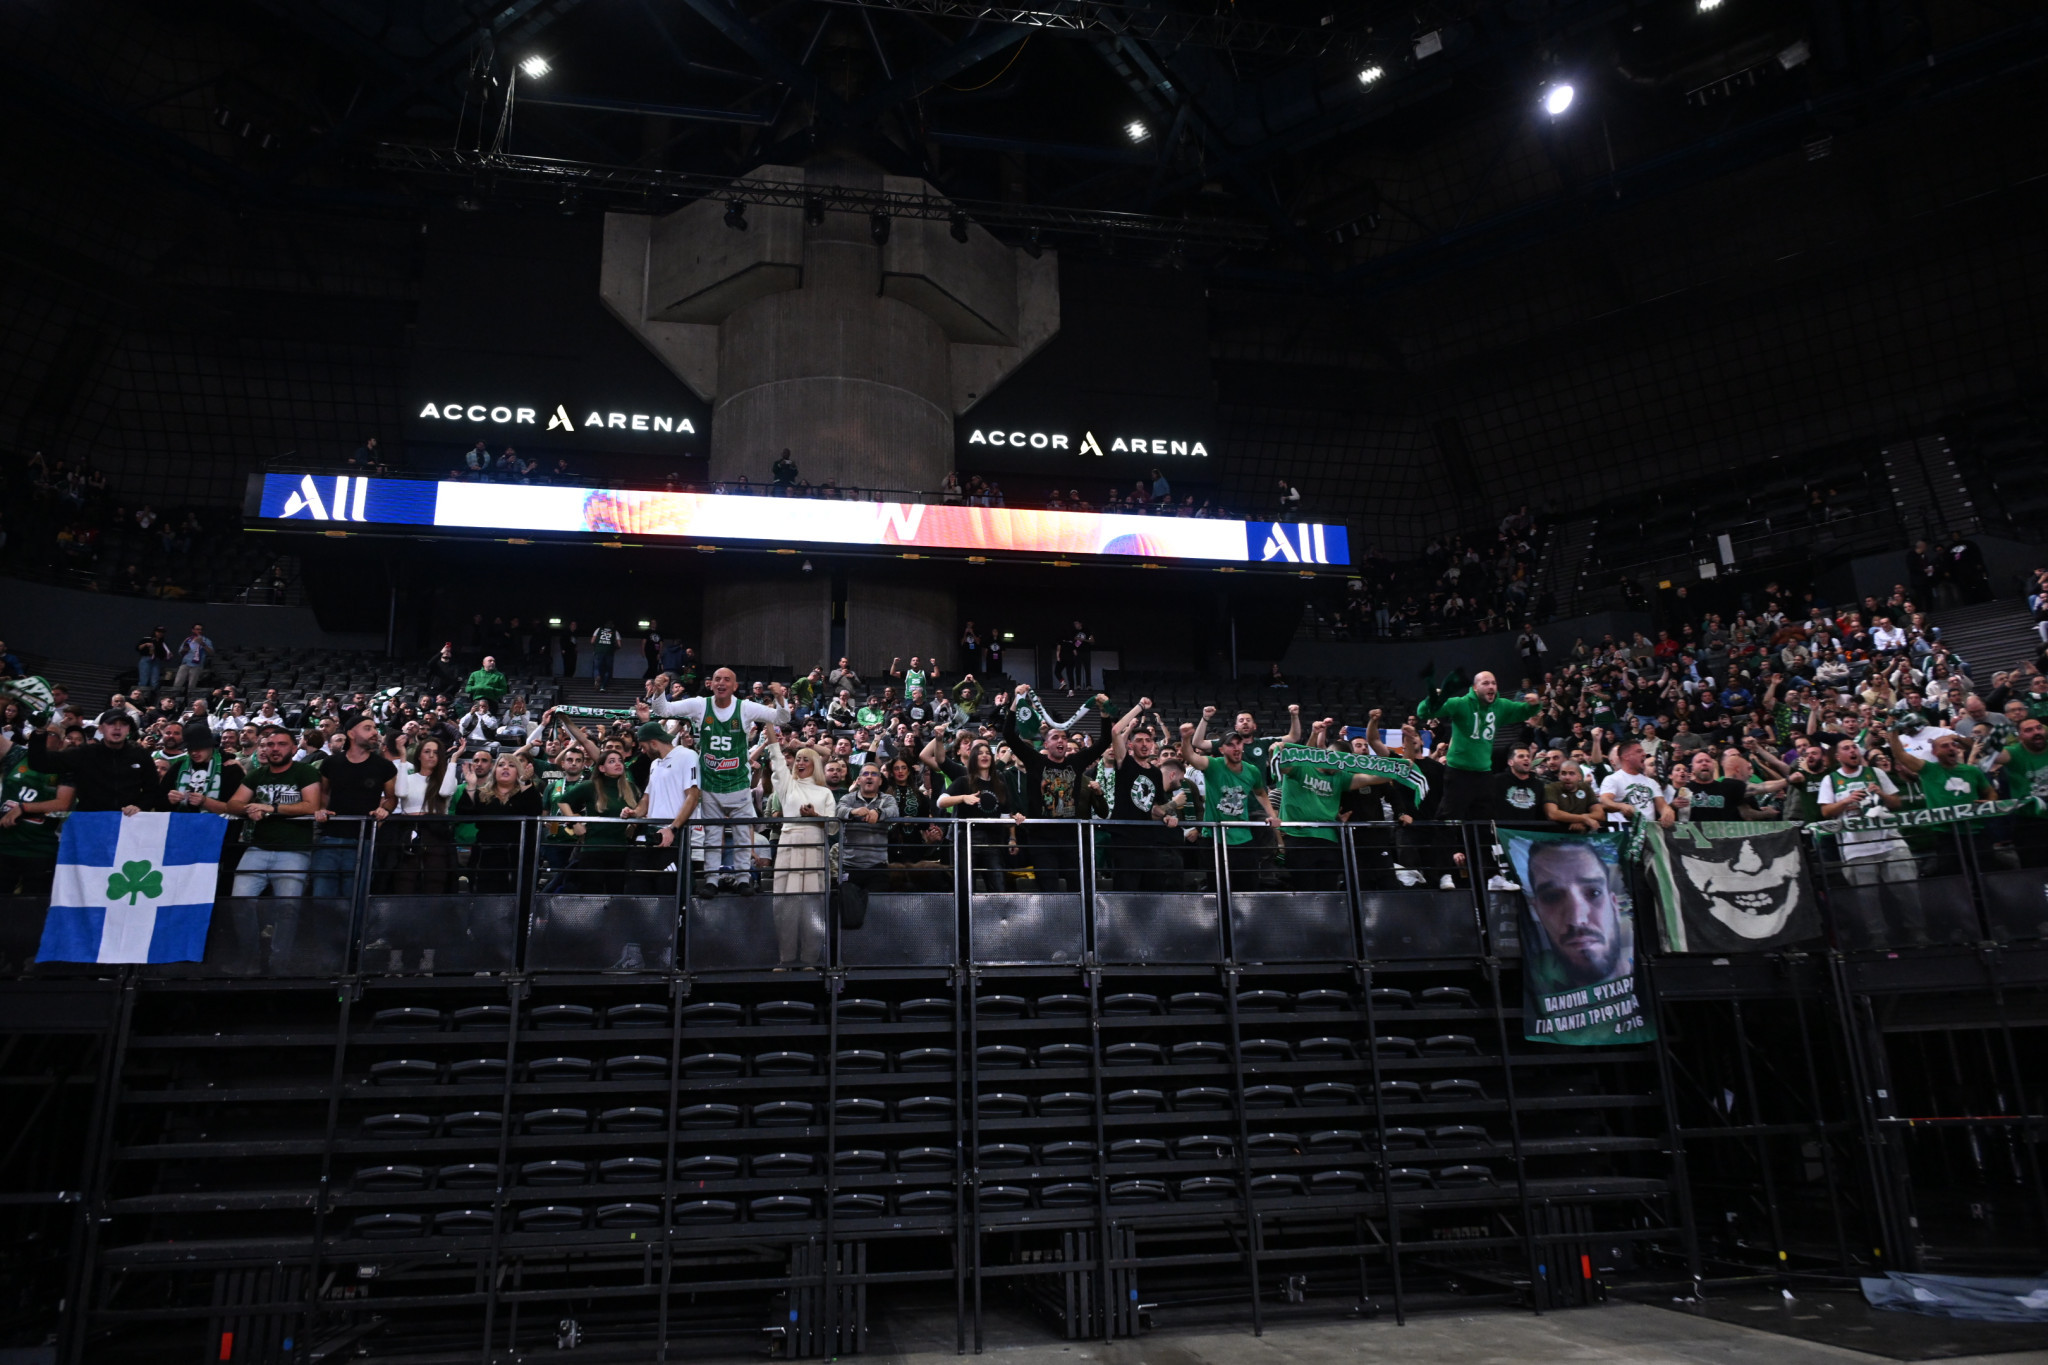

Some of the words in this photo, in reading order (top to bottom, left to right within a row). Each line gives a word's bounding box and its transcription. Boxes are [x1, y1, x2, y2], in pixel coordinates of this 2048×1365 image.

[419, 402, 536, 424] ACCOR
[584, 411, 695, 434] ARENA
[968, 429, 1069, 449] ACCOR
[1111, 437, 1208, 457] ARENA
[1470, 711, 1496, 740] 13
[710, 735, 732, 751] 25
[18, 785, 39, 802] 10
[1535, 1018, 1554, 1034] ΓΙΑ
[1554, 1012, 1587, 1033] ΠΑΝΤΑ
